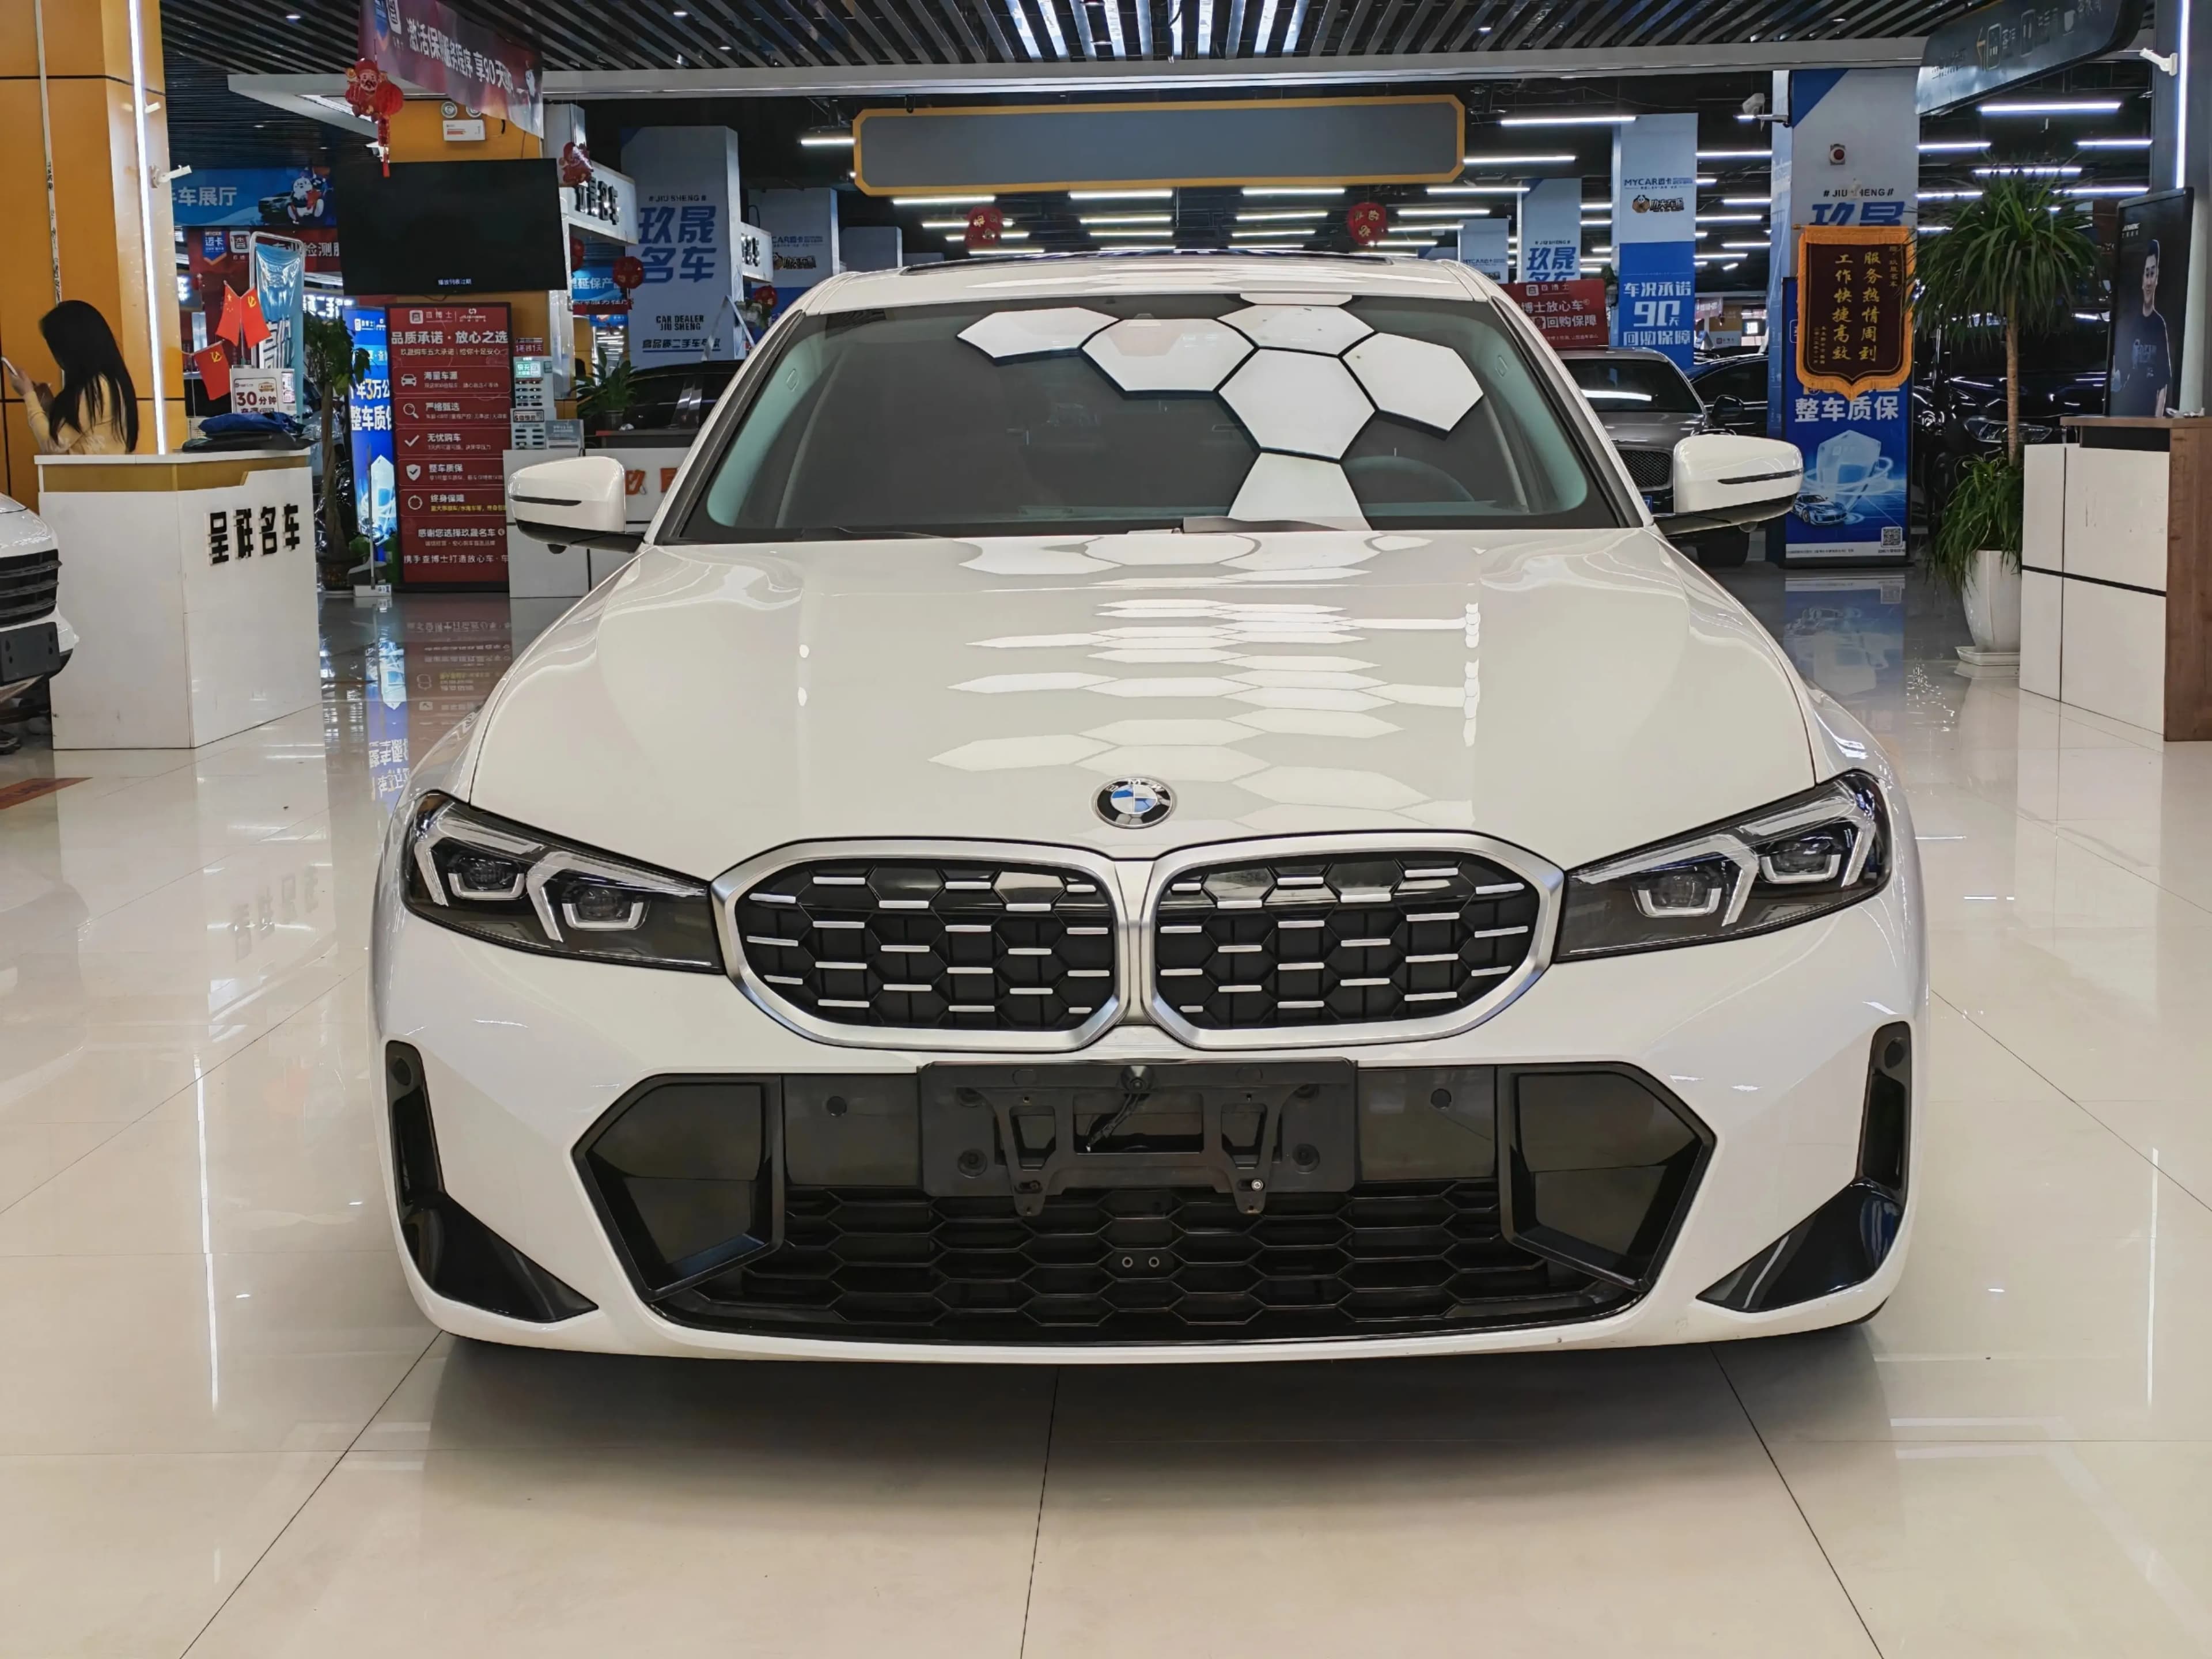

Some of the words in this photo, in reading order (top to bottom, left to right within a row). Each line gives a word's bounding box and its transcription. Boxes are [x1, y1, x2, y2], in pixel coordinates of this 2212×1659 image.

[1850, 188, 1885, 197] HENG
[638, 206, 716, 244] 玖晟
[641, 246, 717, 283] 名车
[1527, 247, 1577, 270] 玖晟
[1623, 281, 1691, 297] 车况承诺
[1518, 300, 1590, 314] 博士放心车®
[1858, 252, 1883, 362] 服务热情周到
[656, 316, 672, 324] CAR
[675, 315, 704, 323] DEALER
[1547, 315, 1597, 328] 回购保障
[674, 323, 701, 331] SHENG
[1623, 330, 1691, 346] 回购保障
[1794, 396, 1899, 422] 整车质保
[427, 433, 461, 442] 无忧购车
[429, 464, 463, 473] 整车质保
[431, 494, 464, 503] 终身保障
